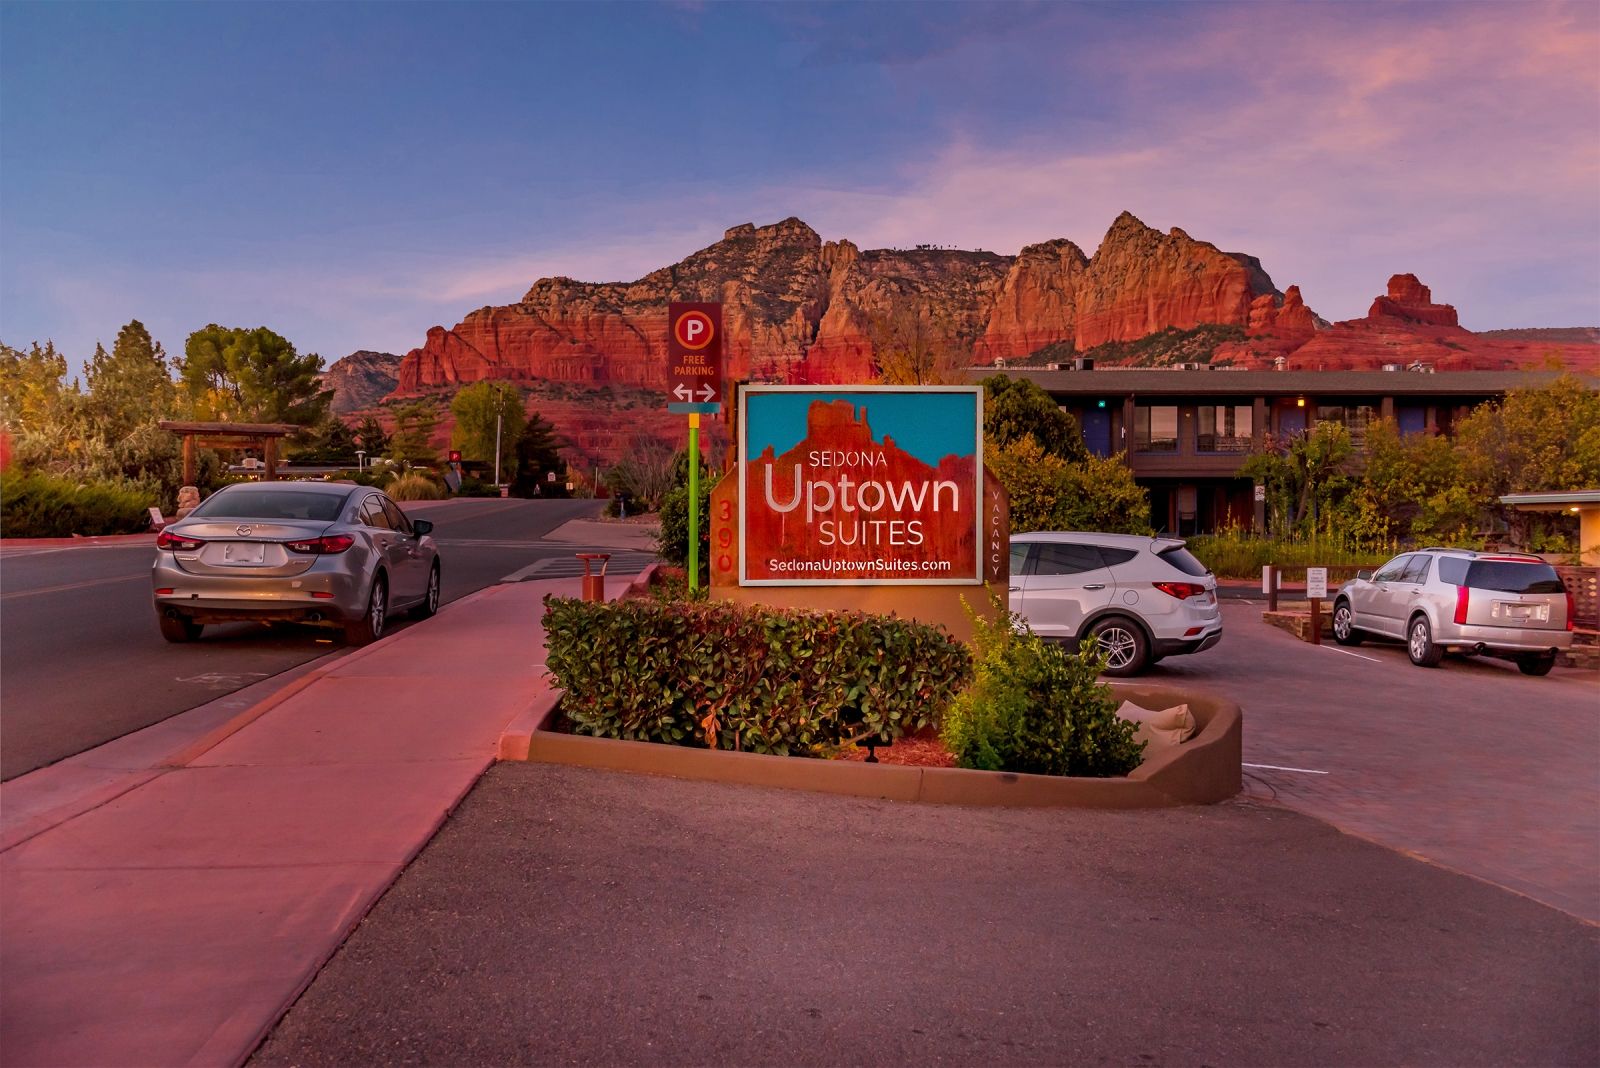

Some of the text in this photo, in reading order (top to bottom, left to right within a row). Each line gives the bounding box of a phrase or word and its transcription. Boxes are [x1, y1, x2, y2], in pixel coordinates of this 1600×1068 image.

[687, 320, 704, 341] P
[683, 355, 705, 364] FREE
[674, 366, 714, 376] PARKING
[809, 451, 887, 467] SEDONA
[764, 463, 959, 523] Uptown
[718, 499, 733, 573] 390
[819, 521, 924, 546] SUITES
[992, 491, 1000, 576] VACANCY
[769, 558, 952, 574] SedonaUptownSuites.com
